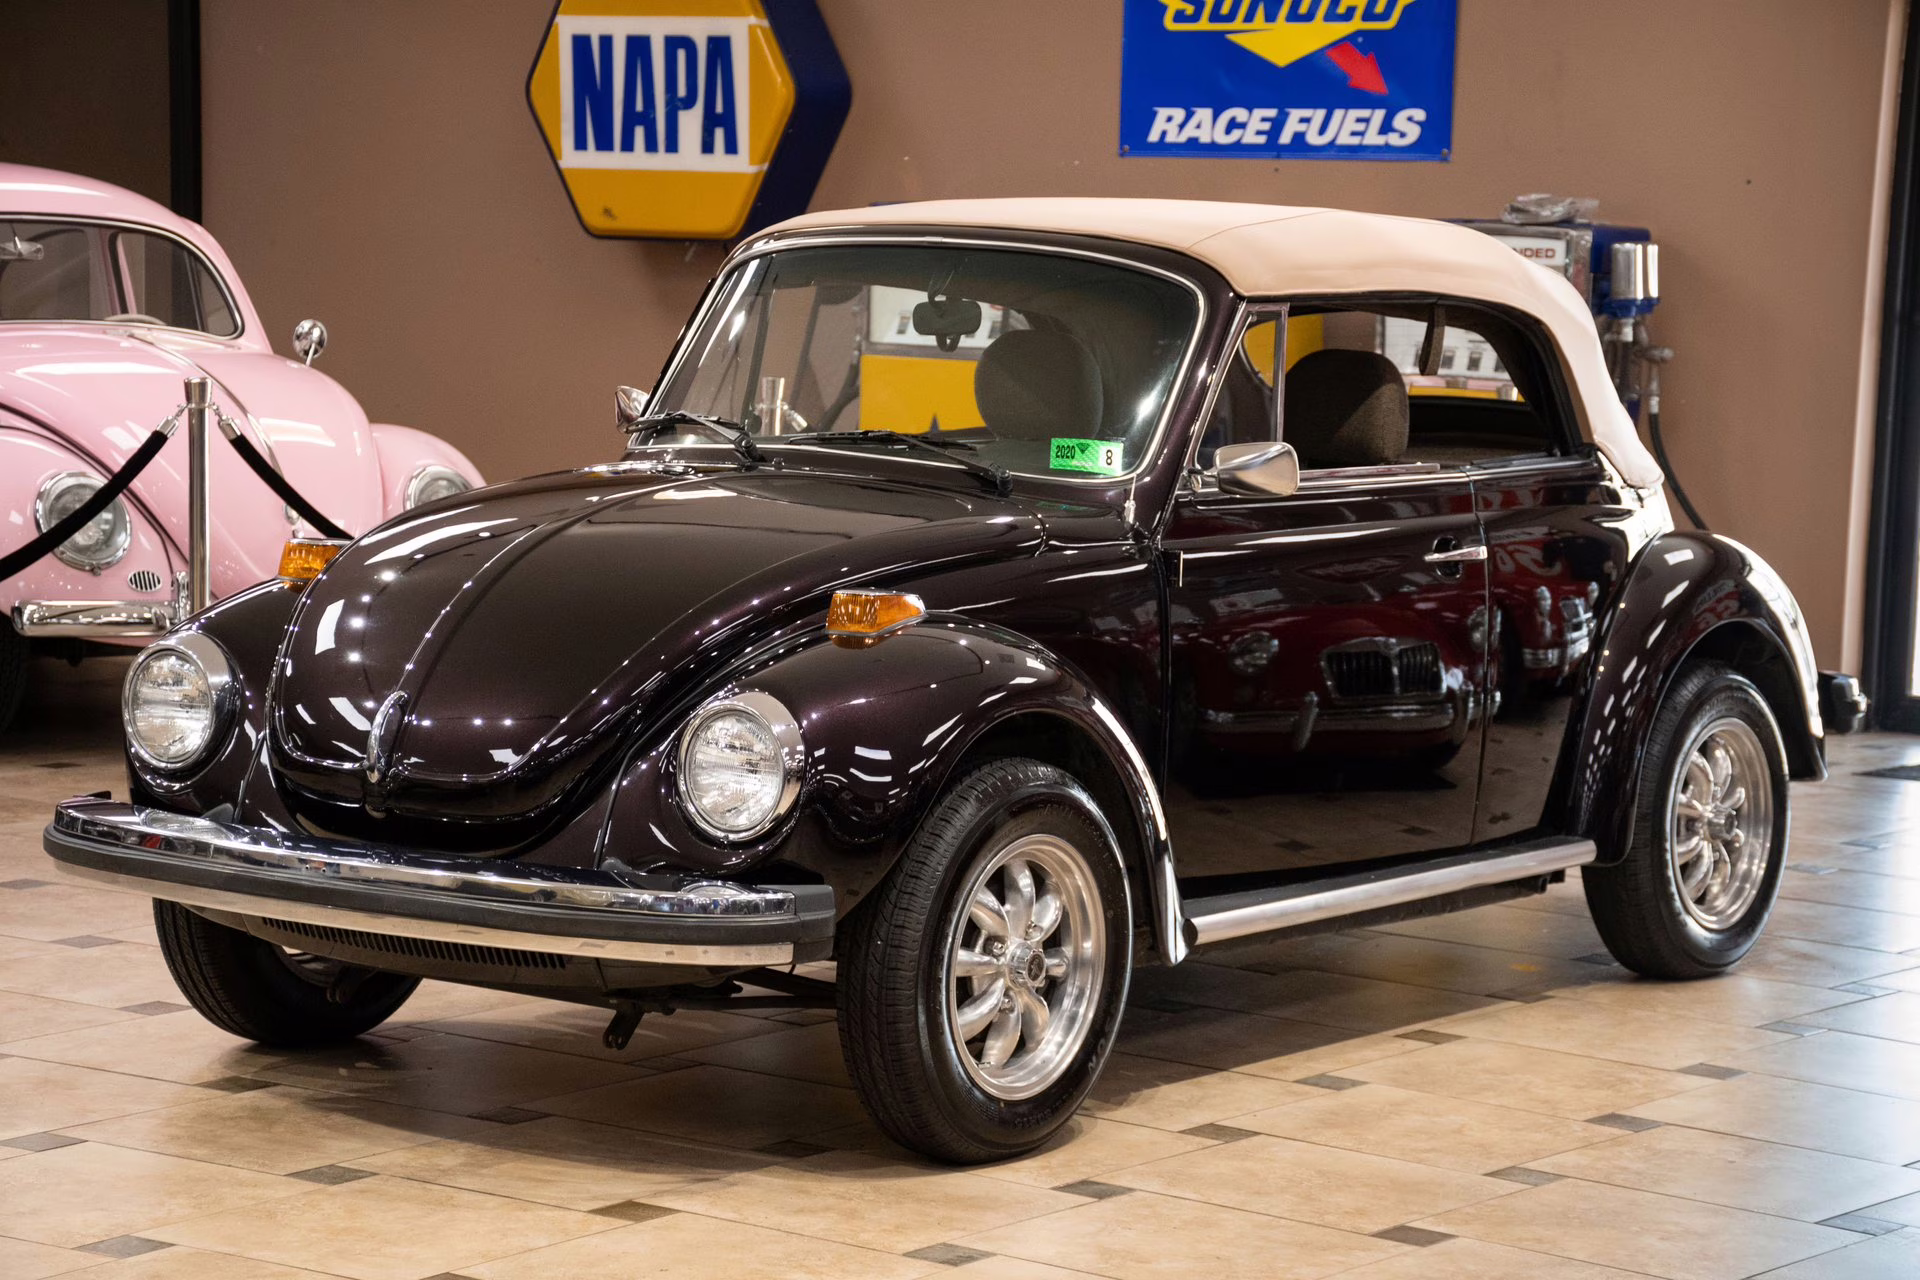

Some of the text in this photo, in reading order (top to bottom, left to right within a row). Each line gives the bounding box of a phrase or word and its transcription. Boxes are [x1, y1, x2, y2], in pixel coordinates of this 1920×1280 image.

[571, 34, 739, 155] NAPA
[1146, 107, 1428, 147] RACE FUELS
[1055, 444, 1113, 466] 2020 8
